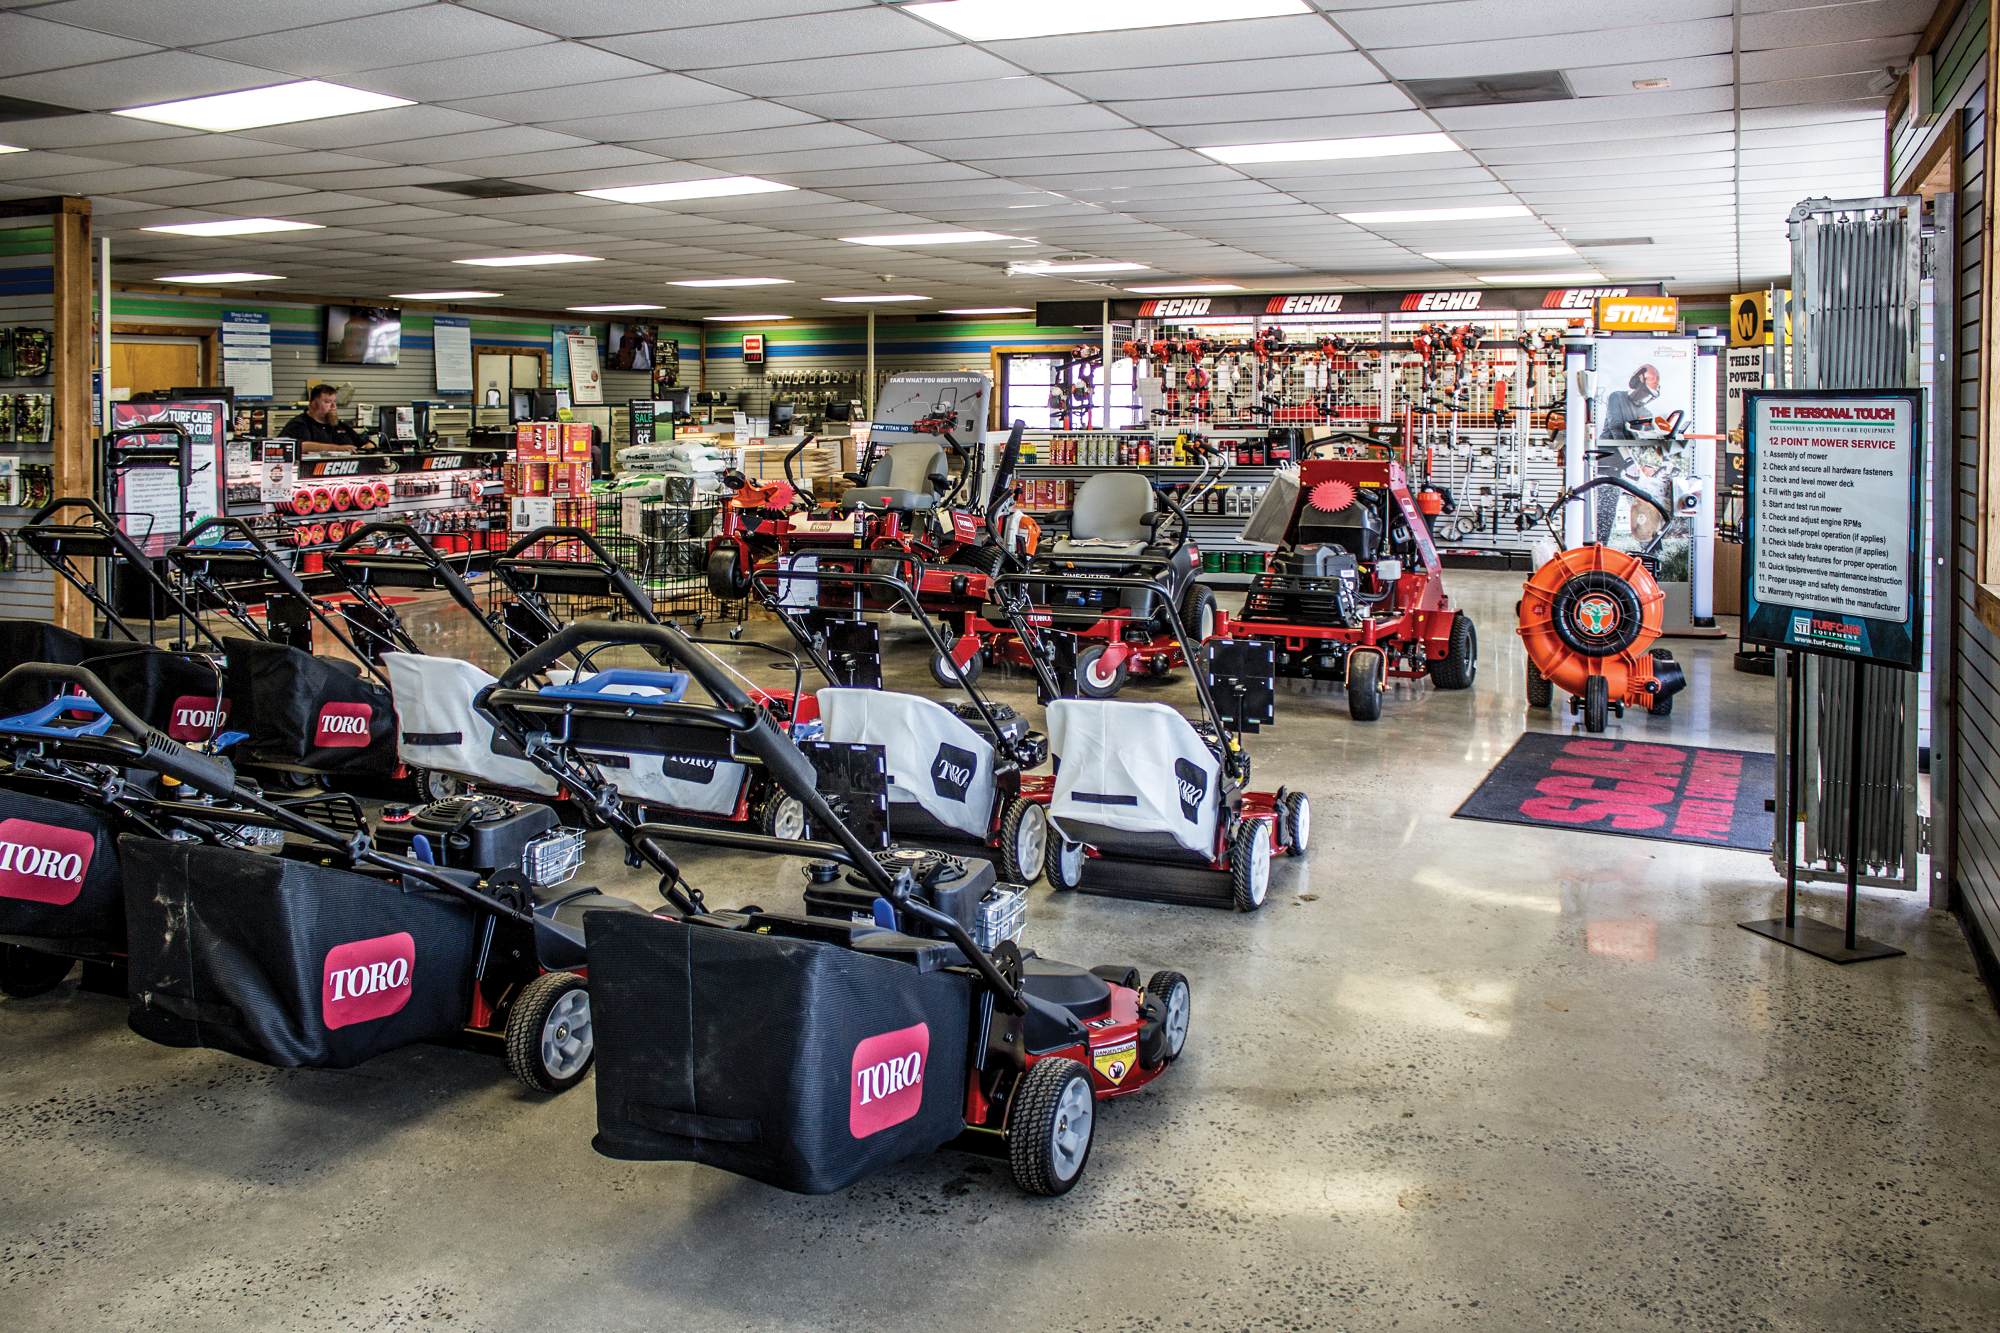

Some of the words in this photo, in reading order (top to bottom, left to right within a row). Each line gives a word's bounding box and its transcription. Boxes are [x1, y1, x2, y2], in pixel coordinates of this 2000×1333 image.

[1153, 298, 1211, 316] ECHO
[1281, 295, 1343, 313] ECHO
[1417, 292, 1482, 310] ECHO
[1604, 305, 1670, 323] STIHL
[1730, 356, 1750, 367] THIS
[1751, 355, 1760, 366] IS
[1729, 372, 1760, 382] POWER
[1729, 388, 1740, 398] ON
[169, 411, 190, 422] TURF
[191, 412, 213, 424] CARE
[634, 413, 653, 423] SALE
[1769, 406, 1791, 418] THE
[1794, 407, 1854, 420] PERSONAL
[1853, 407, 1896, 420] TOUCH
[194, 423, 212, 436] CLUB
[1769, 437, 1779, 446] 12
[1781, 437, 1810, 446] POINT
[1811, 438, 1849, 448] MOWER
[1851, 439, 1896, 450] SERVICE
[431, 456, 462, 469] ECHO
[1769, 450, 1798, 460] Assembly
[323, 461, 359, 476] ECHO
[1763, 462, 1767, 470] 2.
[1769, 462, 1788, 471] Check
[1788, 464, 1800, 472] and
[1832, 466, 1862, 475] hardware
[1863, 467, 1894, 477] fasteners
[1762, 474, 1767, 482] 3.
[1769, 475, 1788, 484] Check
[1801, 477, 1816, 485] level
[1816, 479, 1838, 487] mower
[1838, 479, 1855, 488] deck
[1769, 487, 1778, 495] Fill
[1792, 491, 1804, 499] gas
[1817, 491, 1826, 499] oil
[1762, 499, 1767, 507] 5.
[1768, 500, 1783, 508] Start
[1784, 502, 1795, 510] and
[1796, 503, 1808, 511] test
[958, 520, 973, 528] TORO
[1762, 512, 1768, 520] 6.
[1768, 512, 1787, 521] Check
[1788, 515, 1800, 523] and
[1800, 516, 1820, 525] adjust
[1820, 518, 1842, 528] engine
[1843, 518, 1862, 528] RPMs
[200, 531, 218, 540] VALUE
[1762, 524, 1768, 532] 7.
[1768, 525, 1787, 534] Check
[1788, 528, 1820, 538] self-propel
[1821, 531, 1851, 540] operation
[1852, 533, 1860, 542] (if
[1860, 535, 1886, 545] applies)
[1762, 536, 1768, 544] 8.
[1768, 537, 1787, 546] Check
[1788, 540, 1804, 548] blade
[1805, 541, 1823, 550] brake
[1823, 544, 1854, 554] operation
[1854, 546, 1862, 556] (if
[1862, 548, 1889, 559] applies)
[1761, 549, 1767, 557] 9.
[1768, 550, 1787, 559] Check
[1788, 552, 1806, 563] safety
[1806, 554, 1832, 564] features
[1833, 556, 1842, 565] for
[1843, 560, 1865, 568] proper
[1865, 562, 1897, 572] operation
[1758, 561, 1767, 569] 10.
[1768, 562, 1784, 571] Quick
[1829, 571, 1868, 582] maintenance
[1868, 574, 1903, 586] instruction
[1758, 573, 1766, 581] 11.
[1768, 574, 1788, 585] Proper
[1788, 579, 1807, 588] usage
[1820, 582, 1840, 593] safety
[1840, 584, 1888, 598] demonstration
[1758, 586, 1766, 594] 12.
[1768, 587, 1794, 599] Warranty
[1795, 592, 1830, 602] registration
[1830, 596, 1844, 604] with
[1845, 598, 1856, 606] the
[1857, 600, 1901, 612] manufacturer
[1794, 624, 1809, 634] STI
[1814, 630, 1858, 640] EQUIPMENT
[1794, 636, 1861, 652] www.turf-care.com
[176, 709, 227, 728] TORO
[321, 714, 367, 734] TORO
[938, 759, 968, 788] TORO
[0, 841, 82, 882] TORO
[329, 958, 409, 1002] TORO
[857, 1052, 921, 1106] TORO
